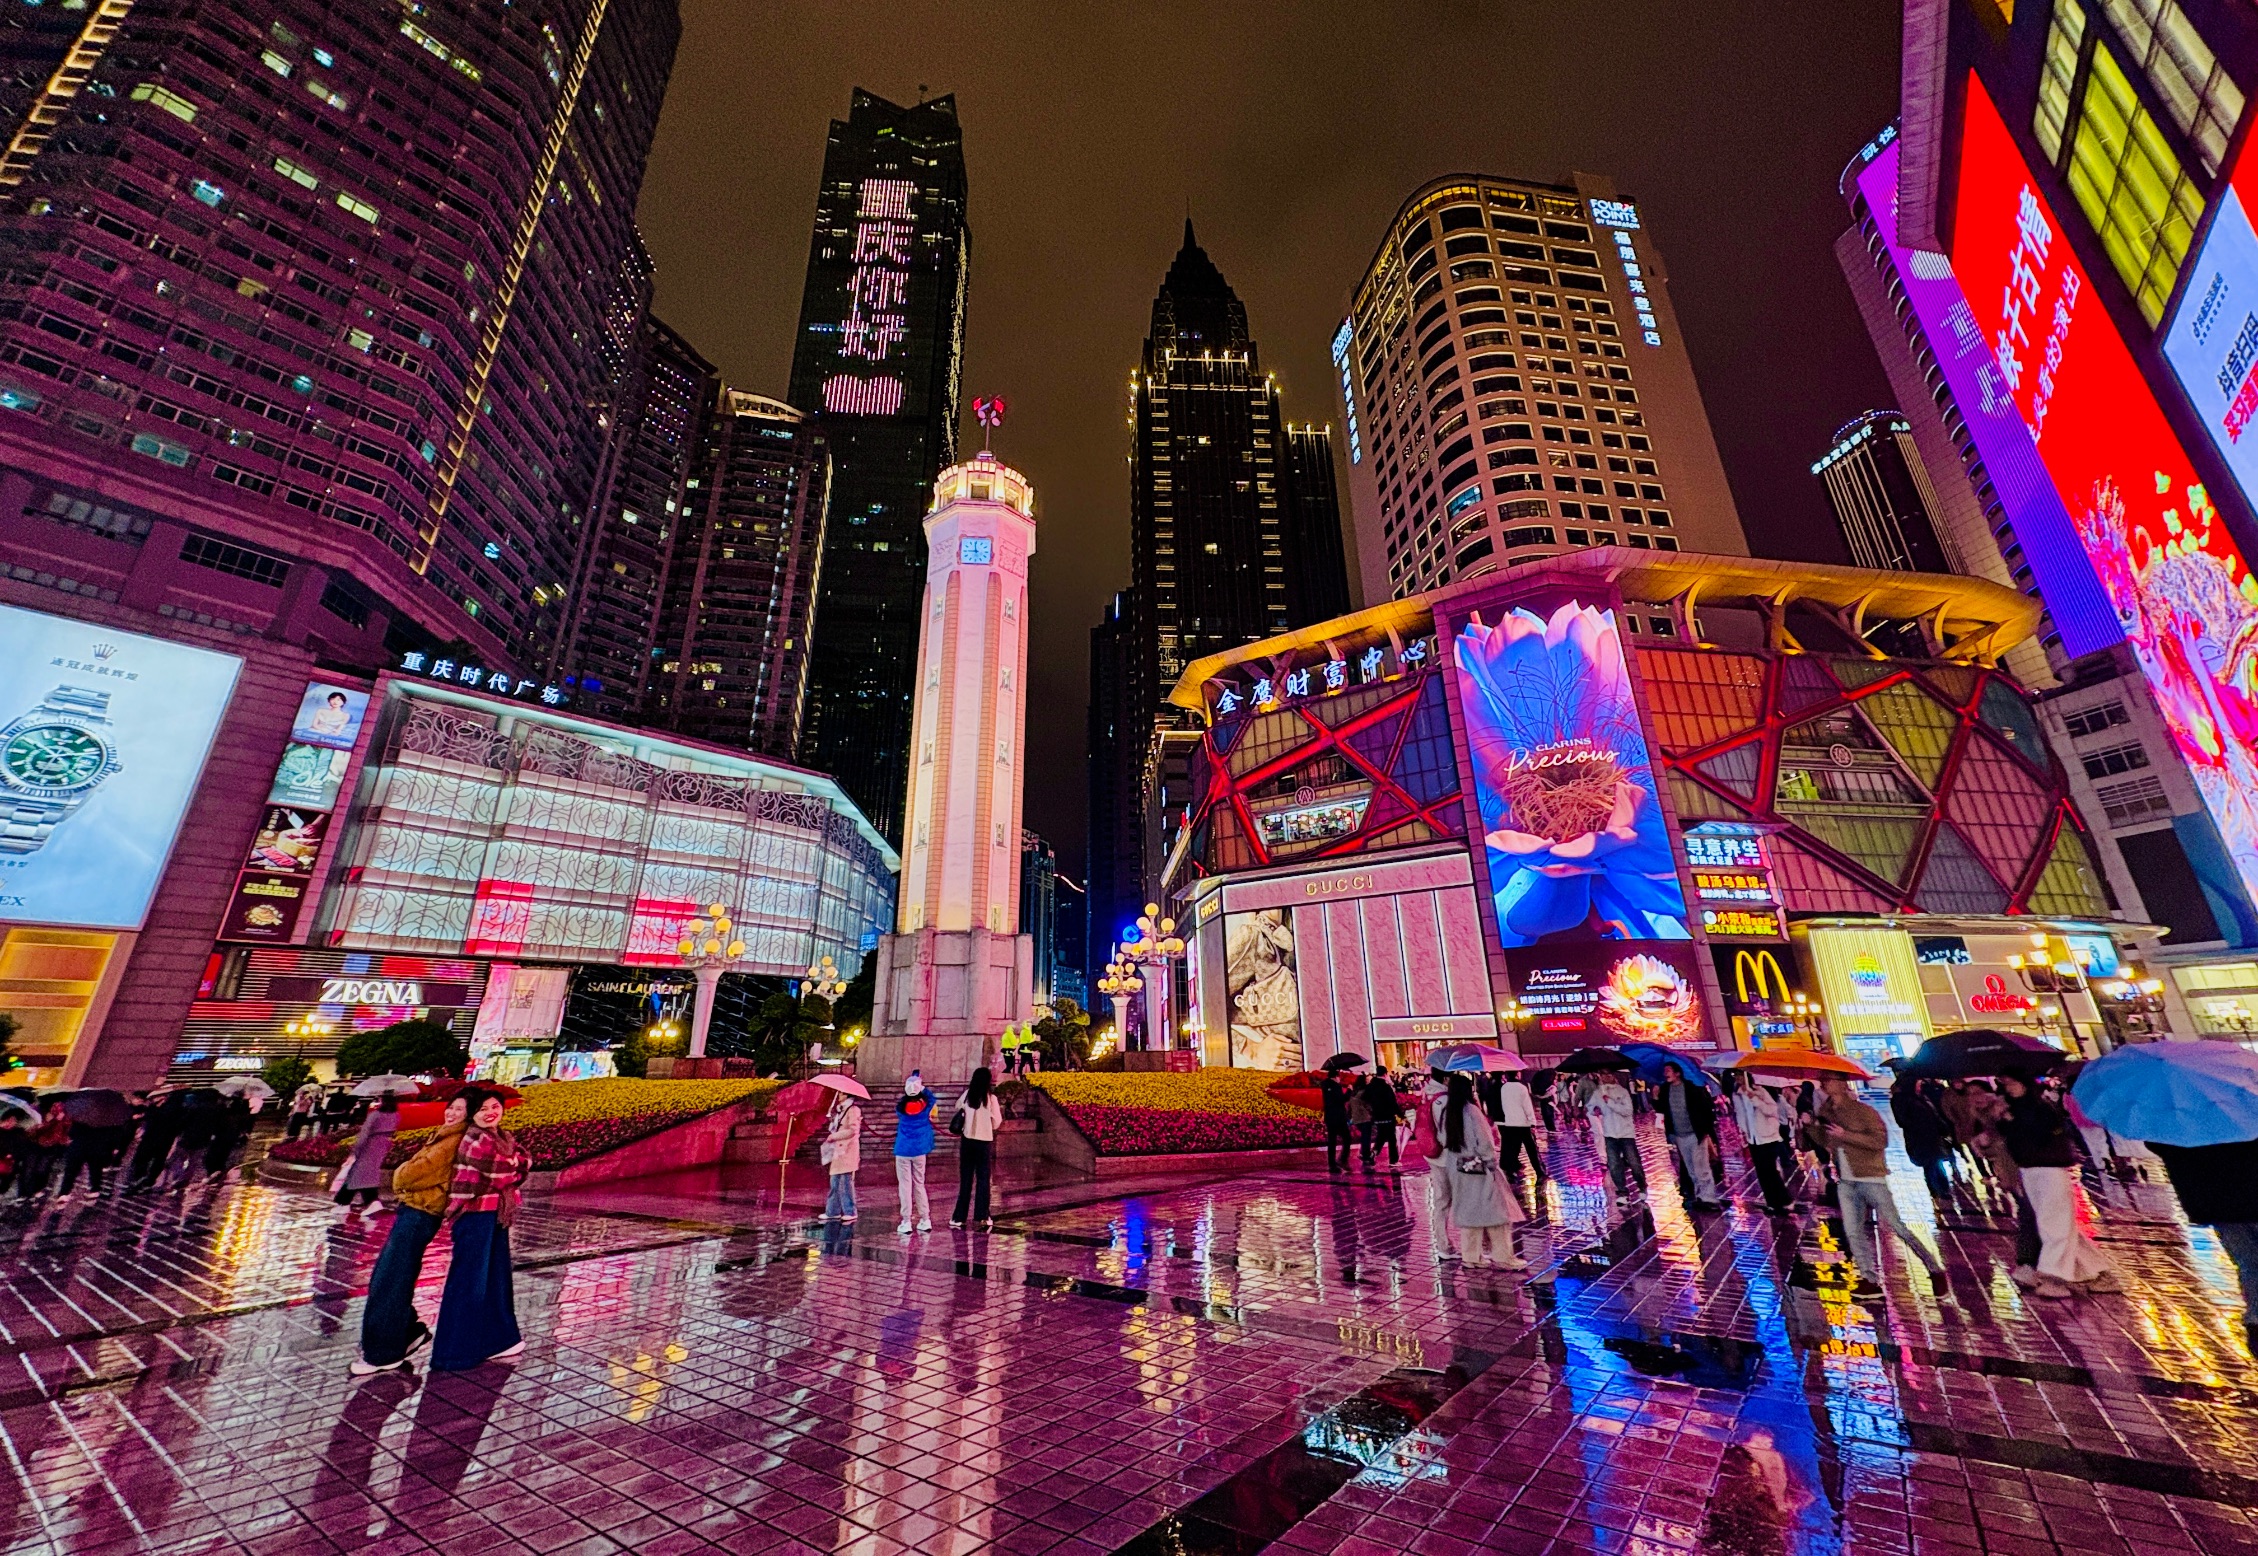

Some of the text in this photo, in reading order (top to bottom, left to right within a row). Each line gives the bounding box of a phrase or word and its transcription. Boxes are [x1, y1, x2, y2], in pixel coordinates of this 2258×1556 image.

[1590, 198, 1623, 213] FOUR
[1592, 208, 1639, 223] POINTS
[1595, 217, 1641, 229] BY SHERATON
[1613, 230, 1662, 346] 福朋喜来登酒店
[400, 651, 561, 705] 重庆时代广场
[1216, 640, 1428, 715] 金鹰财富中心
[1535, 737, 1592, 752] CLARINS
[1503, 746, 1621, 781] Precious
[1306, 874, 1373, 896] GUCCI
[1200, 898, 1219, 919] GUCCI
[1529, 969, 1582, 985] Precious
[318, 979, 422, 1005] ZEGNA
[1233, 992, 1295, 1008] GUCCI
[1412, 1023, 1455, 1034] GUCCI
[213, 1057, 264, 1070] ZEGNA
